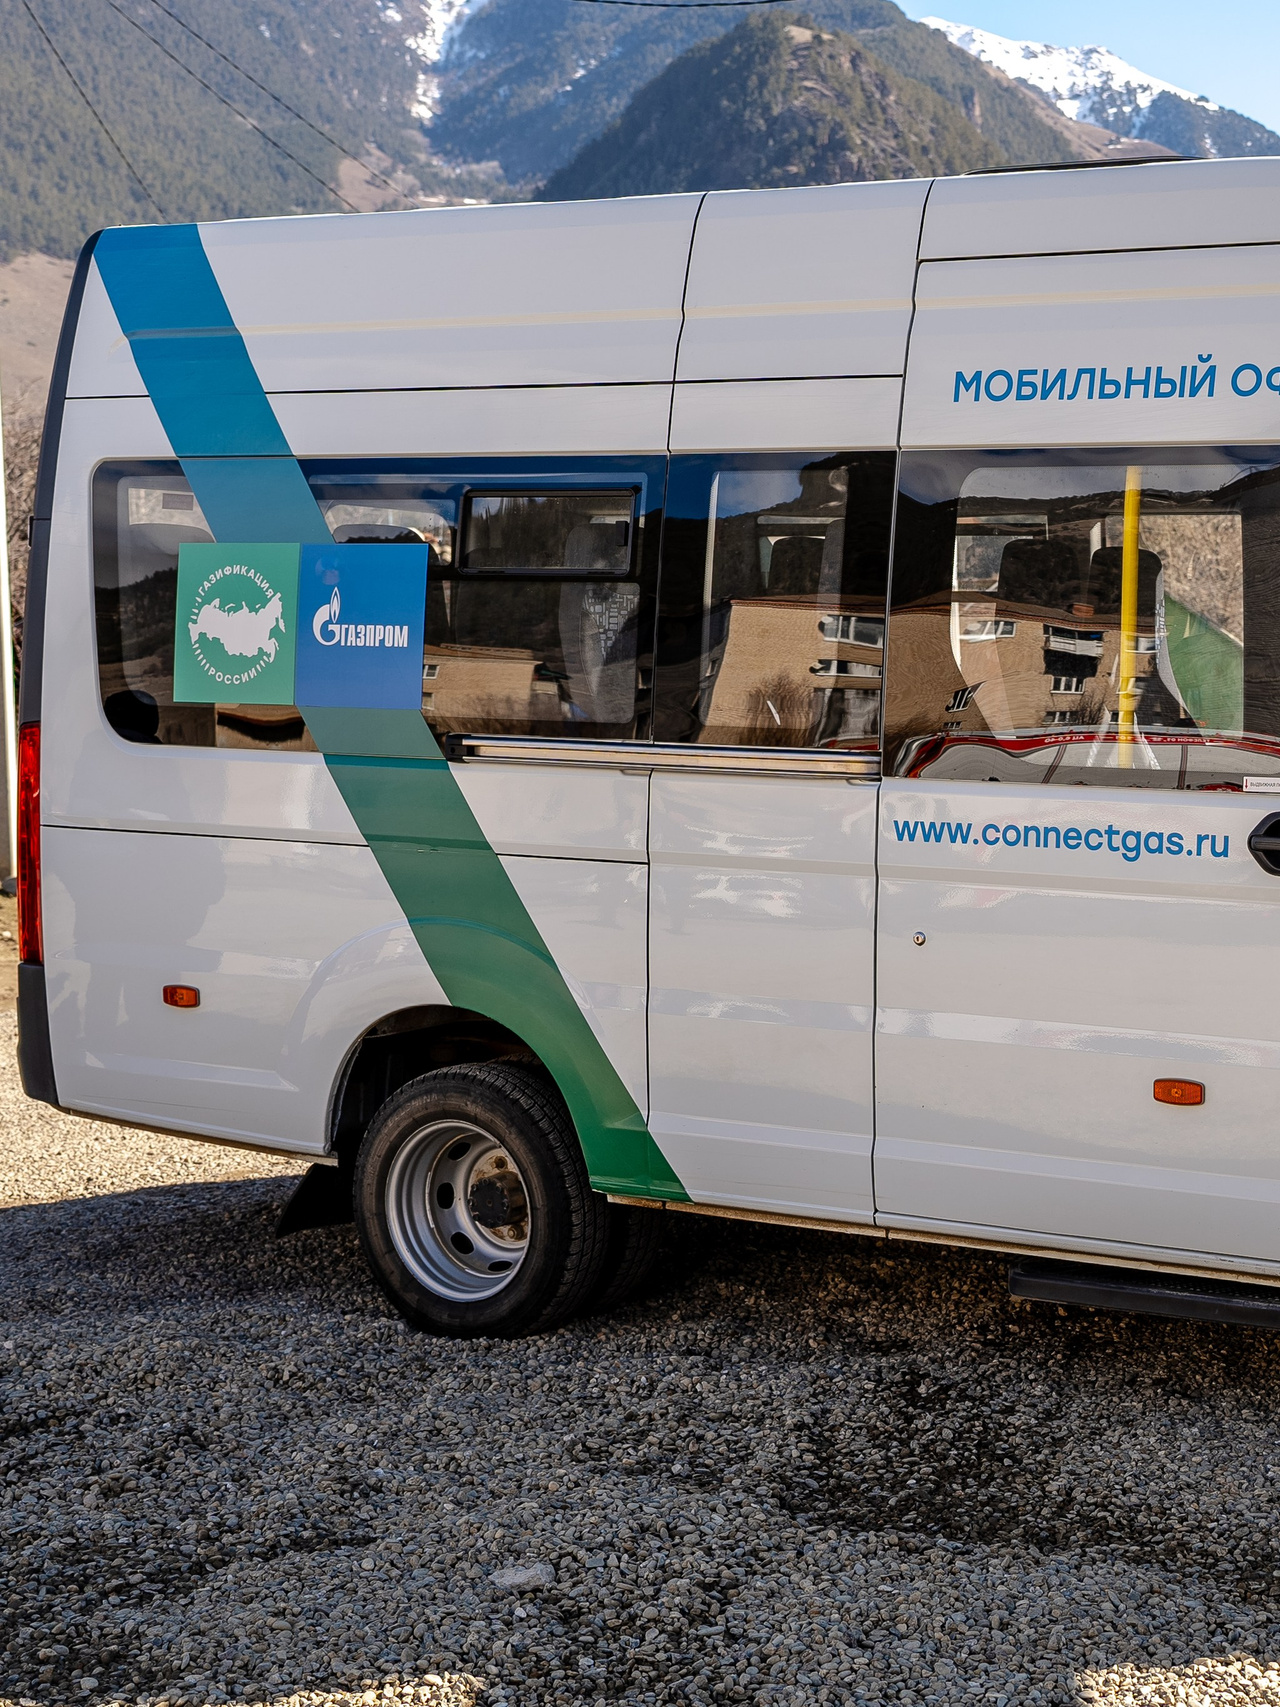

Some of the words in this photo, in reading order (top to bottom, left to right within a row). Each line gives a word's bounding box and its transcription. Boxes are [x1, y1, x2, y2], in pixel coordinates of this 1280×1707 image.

[953, 354, 1218, 403] МОБИЛЬНЫЙ
[199, 565, 274, 598] ГАЗИФИКАЦИЯ
[208, 664, 257, 685] РОССИИ
[893, 818, 1230, 862] www.connectgas.ru
